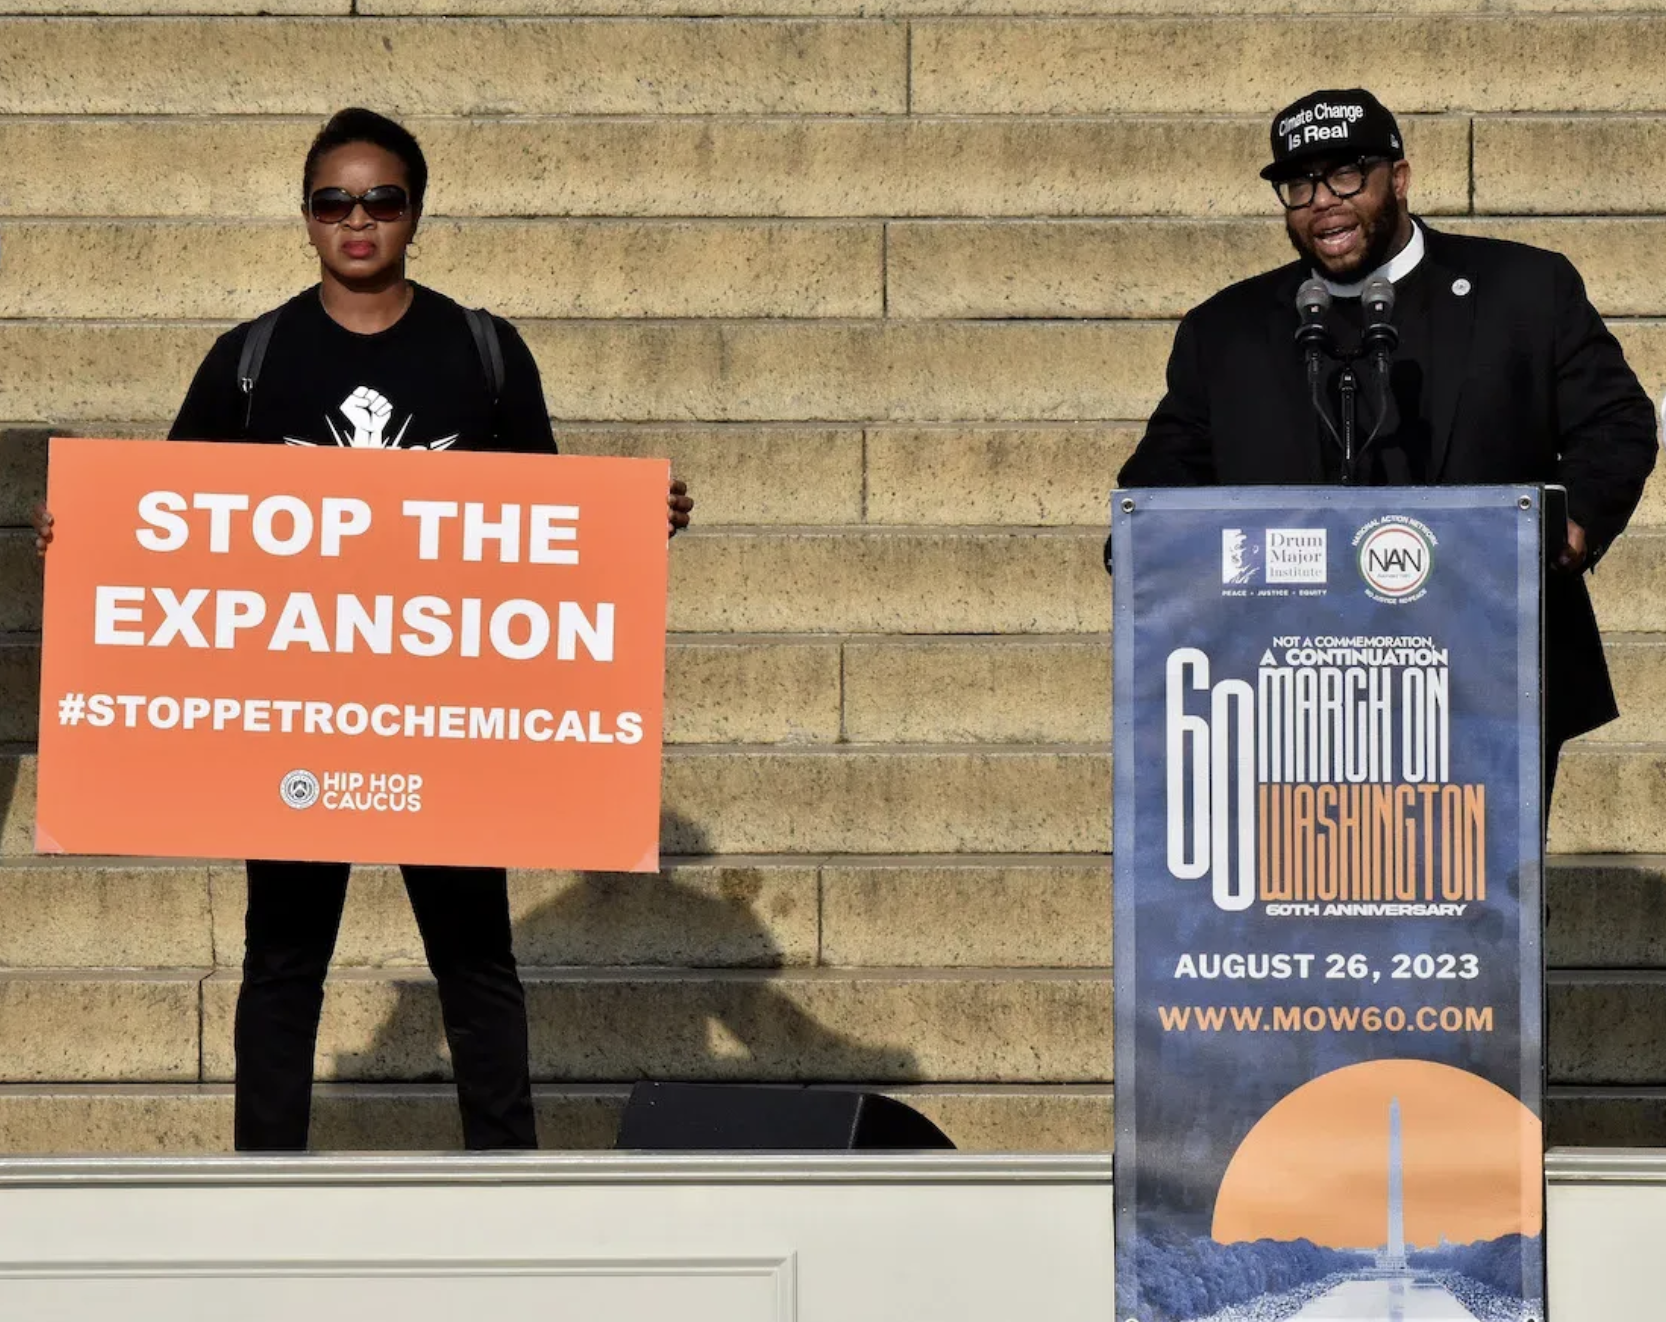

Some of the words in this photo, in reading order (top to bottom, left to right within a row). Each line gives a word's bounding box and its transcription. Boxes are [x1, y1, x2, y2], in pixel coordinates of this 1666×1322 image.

[1279, 109, 1313, 137] Climate
[1314, 102, 1364, 123] Change
[1288, 134, 1301, 151] Is
[1303, 121, 1349, 144] Real
[135, 490, 372, 557] STOP
[402, 501, 580, 565] THE
[1270, 532, 1323, 546] Drum
[1270, 549, 1323, 564] Major
[1369, 548, 1422, 572] NAN
[1270, 566, 1323, 577] Institute
[94, 585, 615, 662] EXPANSION
[1273, 636, 1301, 648] NOT
[1303, 636, 1313, 648] A
[1259, 648, 1277, 666] A
[1285, 648, 1449, 666] CONTINUATION
[58, 693, 644, 745] #STOPPETROCHEMICALS
[1258, 667, 1392, 783] MARCH
[1402, 667, 1449, 783] ON
[323, 772, 364, 792] HIP
[370, 773, 423, 793] HOP
[1166, 647, 1256, 912] 60
[322, 791, 422, 812] CAUCUS
[1259, 784, 1486, 901] WASHINGTON
[1265, 904, 1320, 916] 60TH
[1323, 904, 1467, 917] ANNIVERSARY
[1173, 953, 1315, 979] AUGUST
[1325, 953, 1381, 983] 26,
[1390, 953, 1479, 979] 2023
[1158, 1006, 1494, 1032] WWW.MOW60.COM
